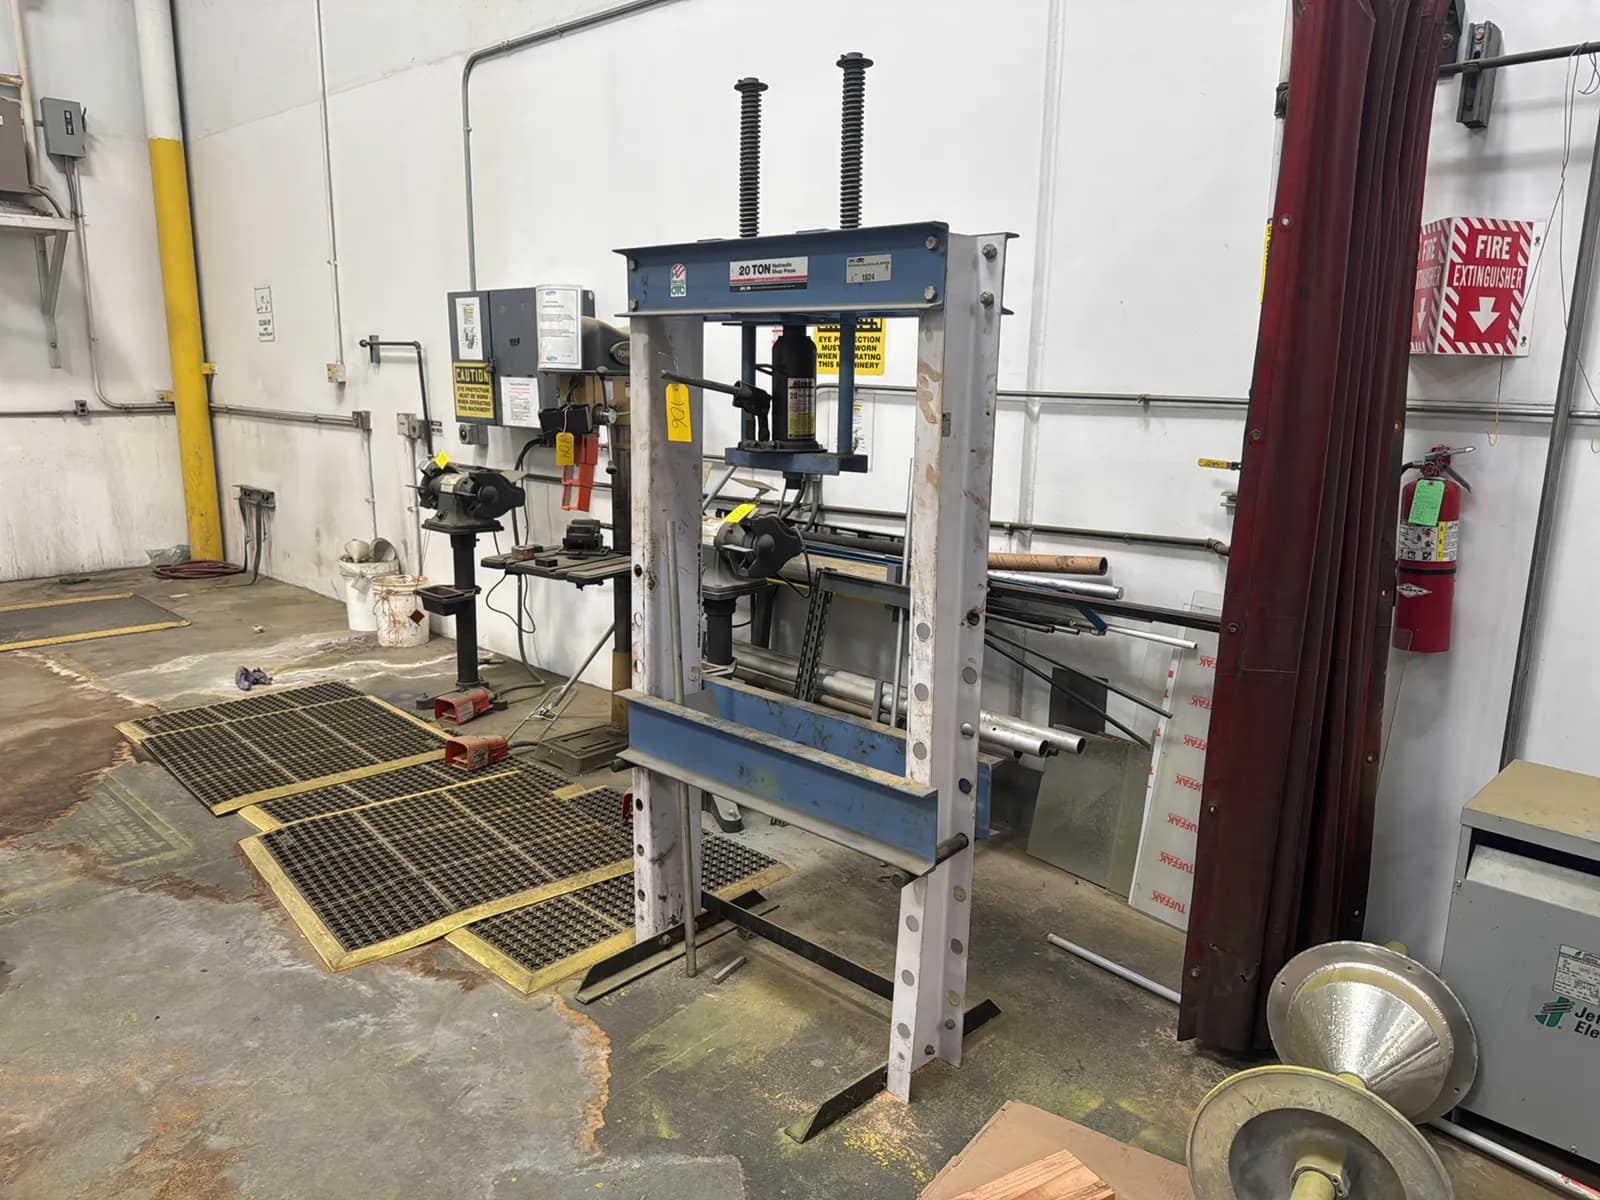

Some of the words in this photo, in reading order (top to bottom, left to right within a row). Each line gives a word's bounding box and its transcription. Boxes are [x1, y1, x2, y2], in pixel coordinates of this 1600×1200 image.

[1475, 235, 1512, 260] FIRE
[739, 265, 750, 276] 20
[752, 263, 771, 275] TON
[1453, 265, 1523, 289] EXTINGUISHER
[817, 352, 838, 360] WHEN
[1183, 735, 1208, 751] FFAK
[1167, 812, 1198, 832] UFFAK
[1159, 851, 1194, 874] TUFFAK
[1152, 889, 1186, 914] TUFFAK
